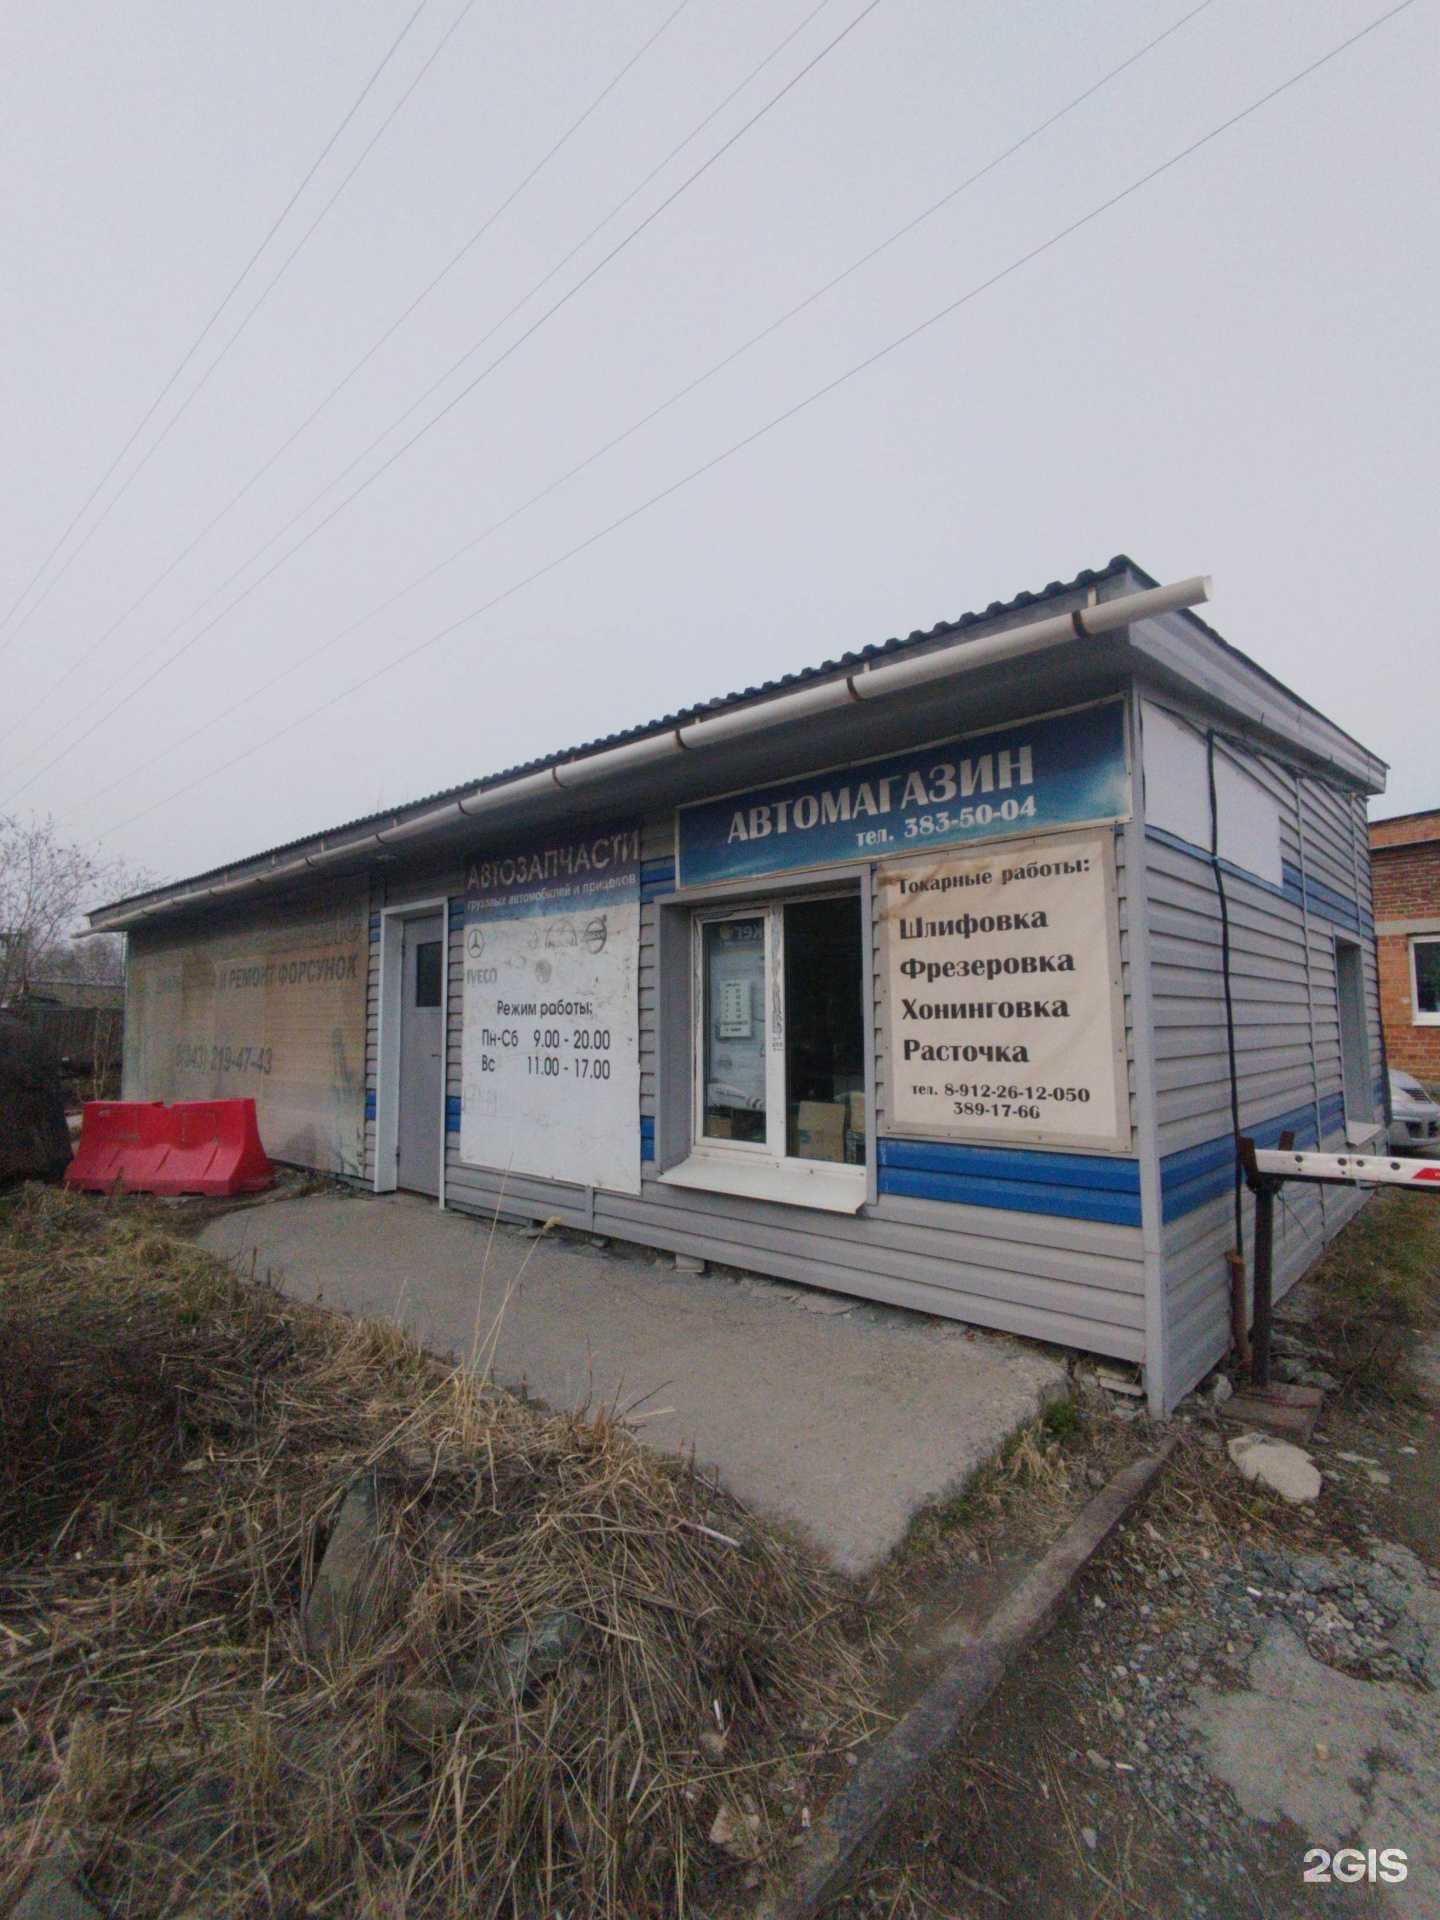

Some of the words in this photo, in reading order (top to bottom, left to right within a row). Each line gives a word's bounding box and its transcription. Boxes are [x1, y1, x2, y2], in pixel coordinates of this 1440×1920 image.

[727, 745, 1034, 844] АВТОМАГАЗИН
[856, 830, 894, 847] тел.
[904, 795, 1036, 838] 383-50-04
[467, 829, 639, 890] АВТОЗАПЧАСТИ
[900, 871, 992, 895] Токарные
[1001, 859, 1090, 885] работы:
[900, 910, 1049, 939] Шлифовка
[900, 953, 1075, 983] Фрезеровка
[496, 1000, 537, 1016] Режим
[902, 998, 1070, 1020] Хонинговка
[482, 1029, 518, 1047] Пн-Сб
[533, 1030, 560, 1048] 9.00
[573, 1030, 610, 1050] 20.00
[904, 1039, 1029, 1063] Расточка
[481, 1054, 496, 1072] Вс
[528, 1056, 560, 1076] 11.00
[574, 1058, 610, 1080] 17.00
[912, 1085, 938, 1096] тел.
[944, 1083, 1090, 1102] 8-912-26-12-050
[953, 1102, 1040, 1119] 389-17-66
